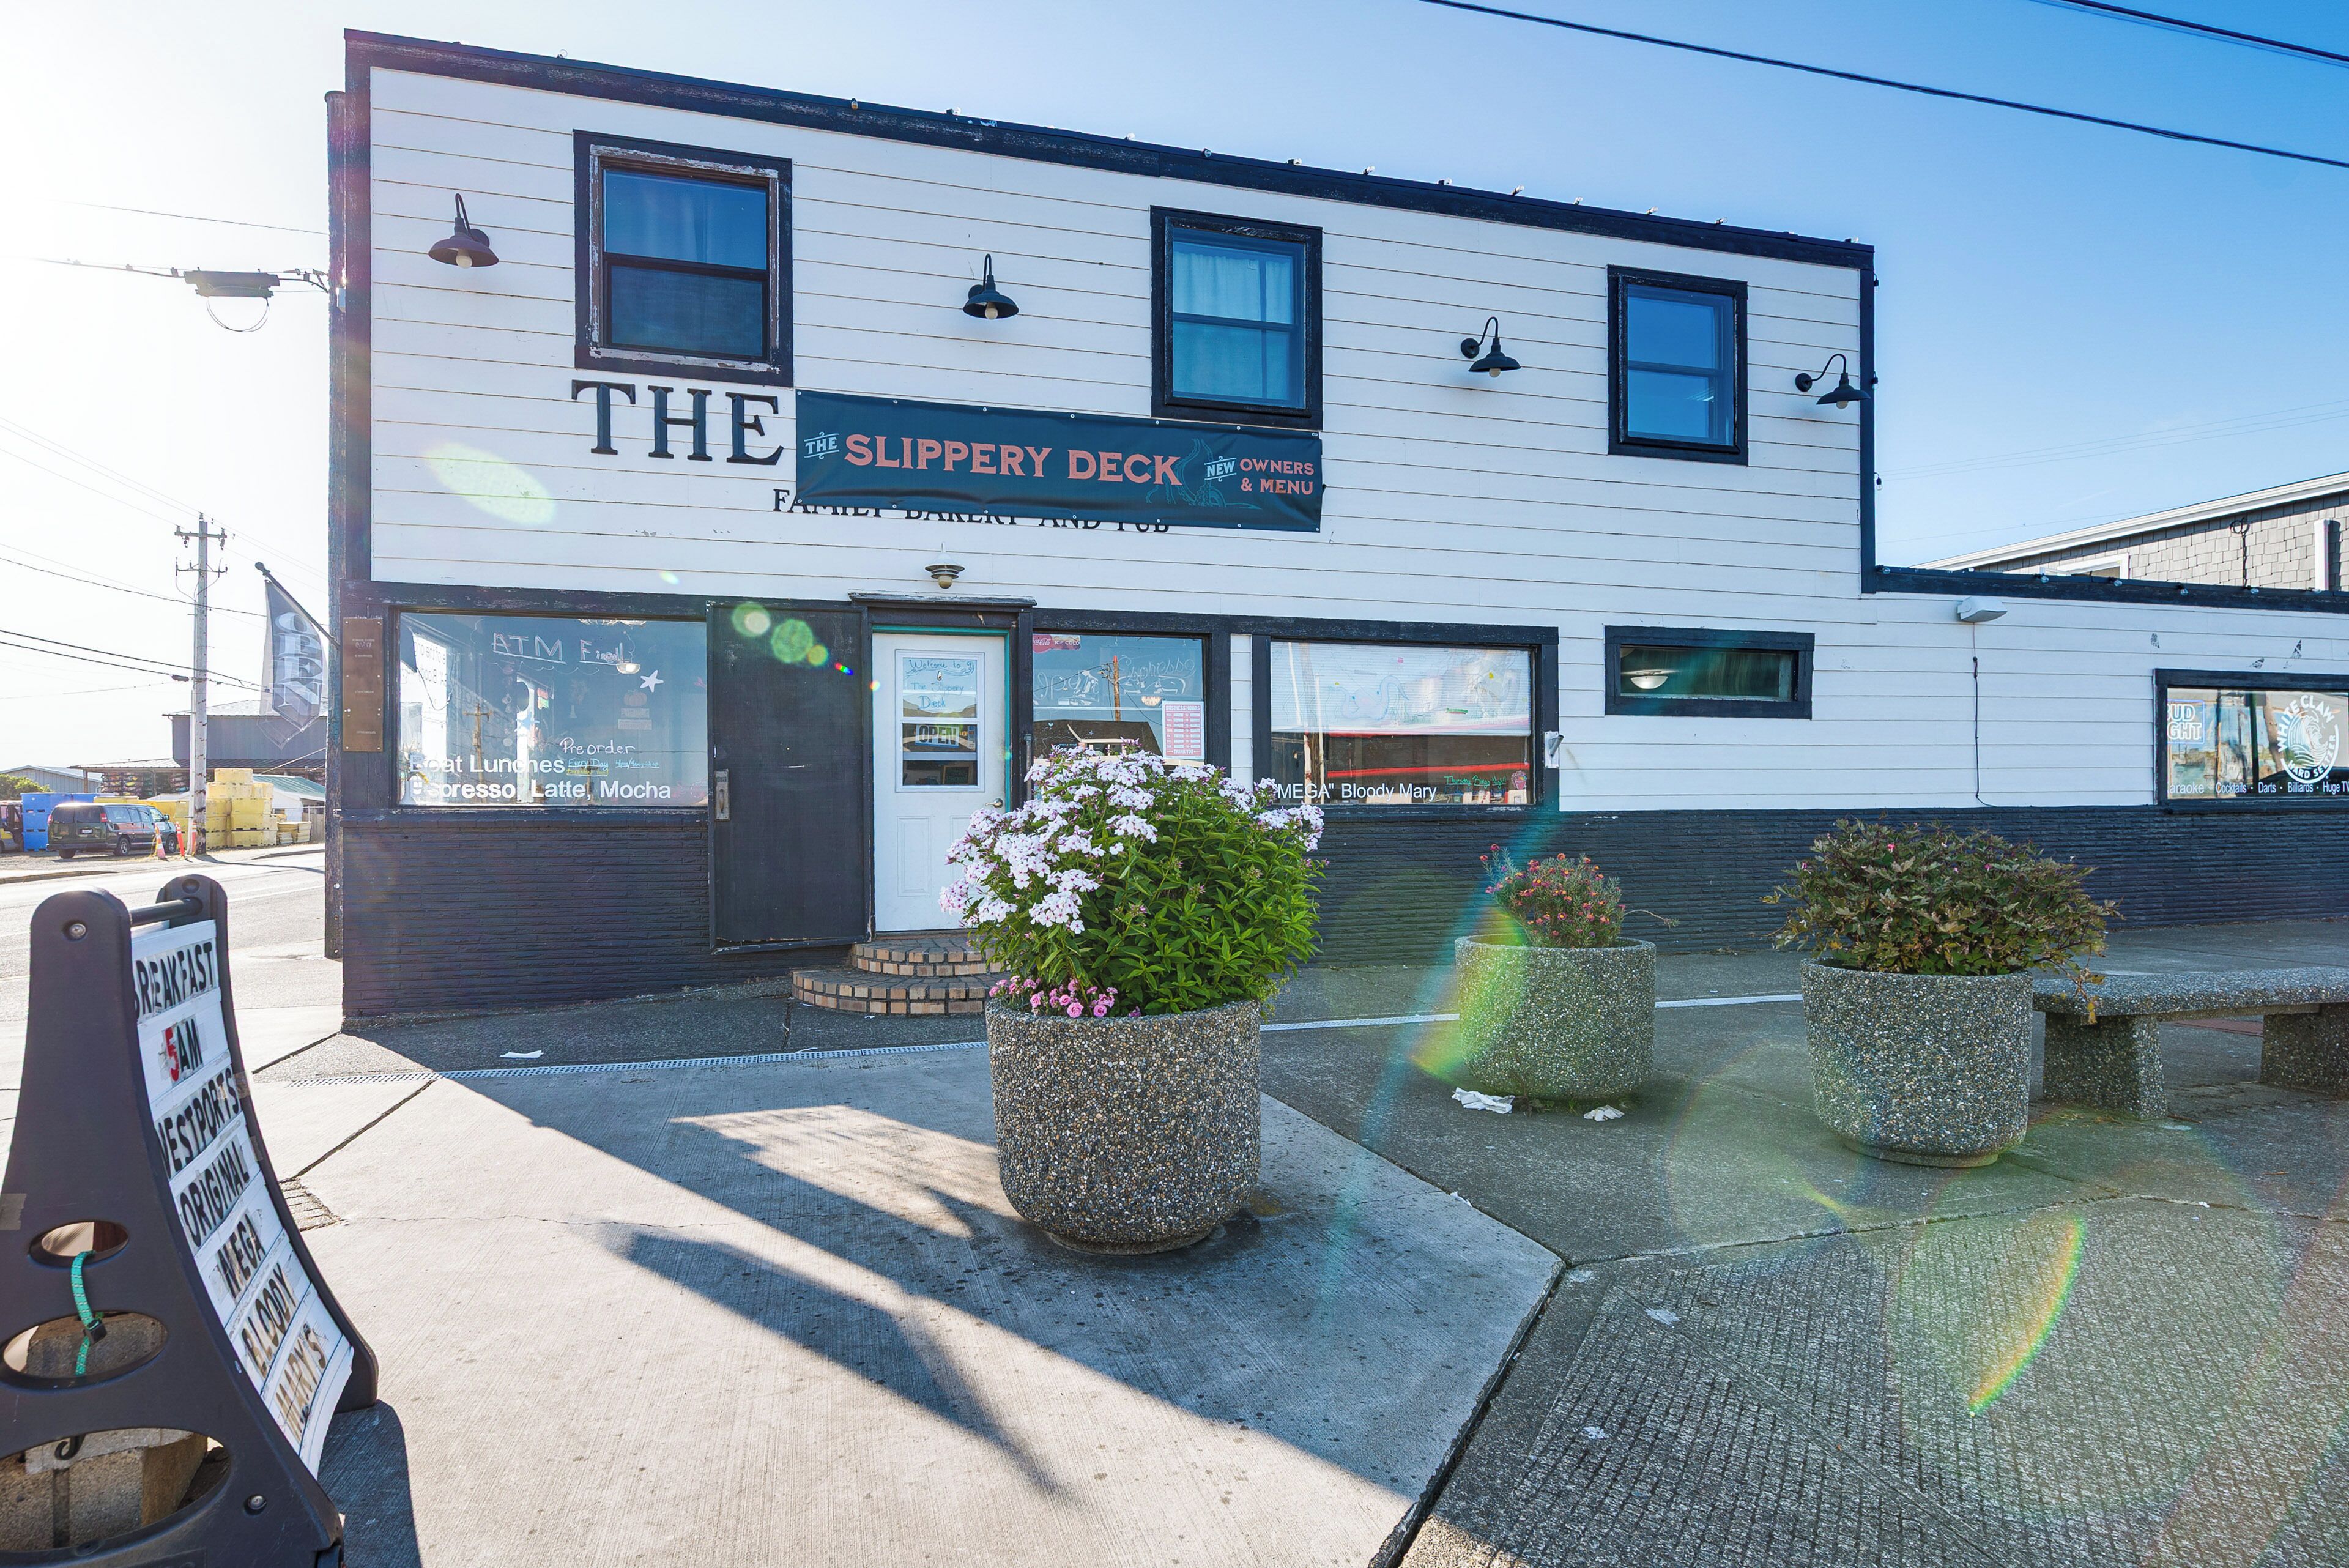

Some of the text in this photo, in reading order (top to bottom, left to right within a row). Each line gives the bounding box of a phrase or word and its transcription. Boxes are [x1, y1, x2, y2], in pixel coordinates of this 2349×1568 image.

[571, 379, 784, 465] THE
[804, 434, 1182, 486] THE SLIPPERY DECK
[1207, 458, 1314, 477] NEW OWNERS
[1241, 478, 1313, 495] & MENU
[492, 633, 563, 661] ATM
[275, 612, 322, 708] OPEN
[954, 660, 961, 669] to
[2167, 722, 2202, 740] GHT
[2277, 695, 2335, 752] WHITE CLAW
[919, 725, 957, 745] OPEN
[410, 753, 565, 773] Boat Lunches
[2288, 735, 2336, 779] HARD SELTZER
[531, 779, 591, 800] Latte,
[601, 781, 670, 798] Mocha
[1277, 783, 1334, 798] MEGA"
[1341, 783, 1394, 801] Bloody
[1400, 783, 1437, 802] Mary
[2167, 782, 2204, 793] araoke
[2216, 782, 2247, 793] Cocktails
[2258, 782, 2276, 793] Darts
[2288, 781, 2314, 793] Billiards
[2323, 781, 2340, 795] Huge
[180, 1141, 250, 1247] ORIGINAL
